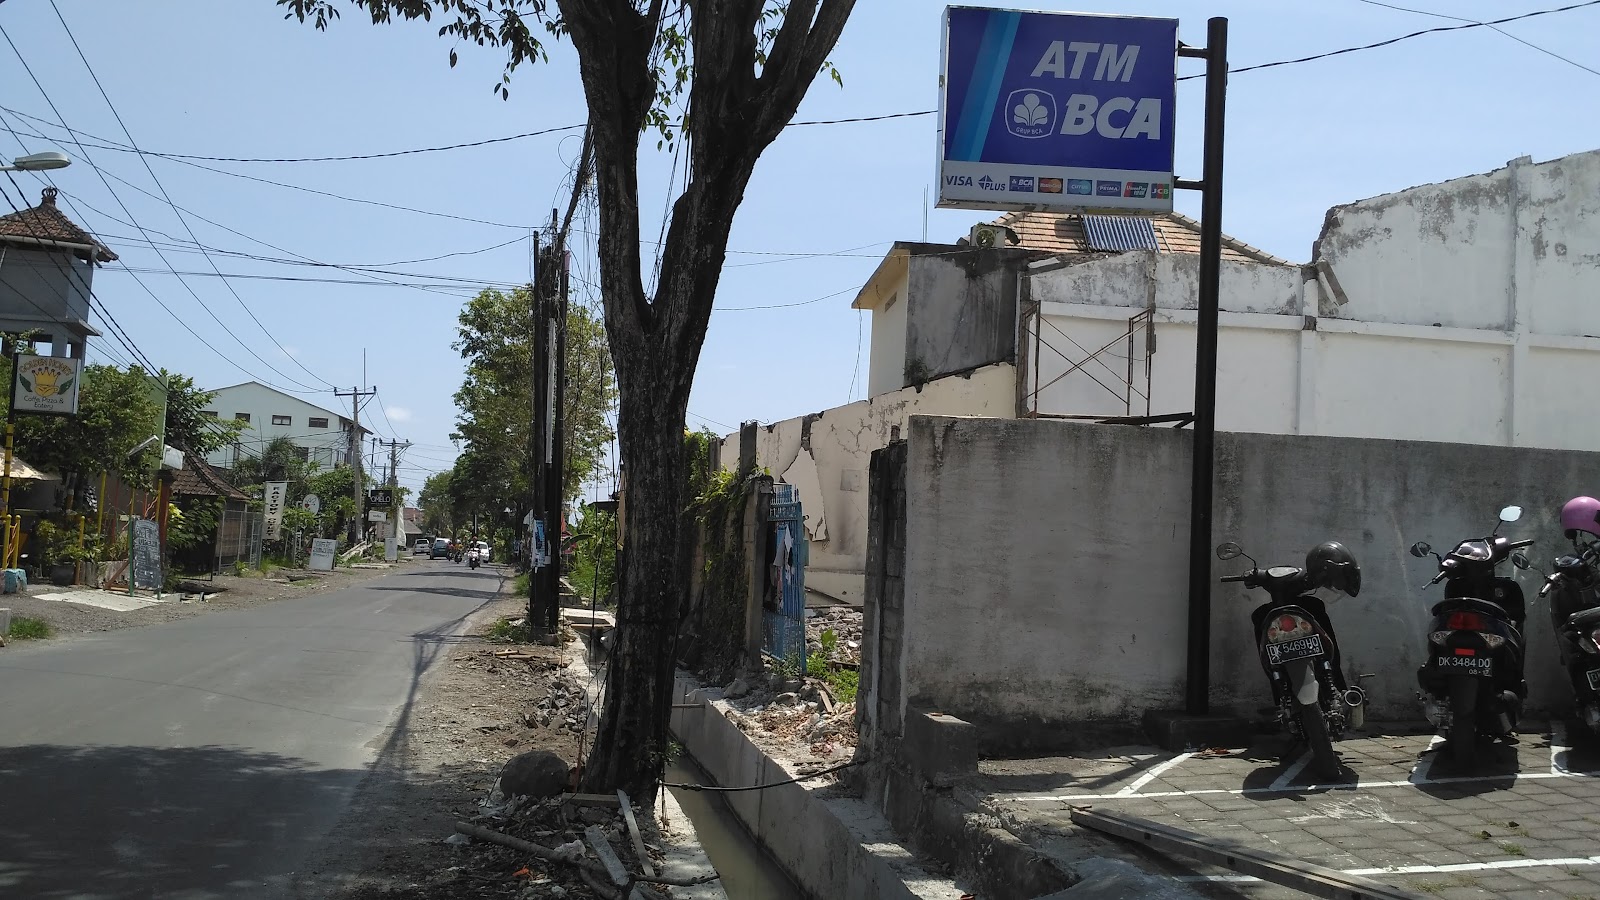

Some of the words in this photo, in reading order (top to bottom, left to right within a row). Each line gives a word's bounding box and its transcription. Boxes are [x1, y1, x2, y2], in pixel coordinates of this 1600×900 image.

[1030, 39, 1141, 83] ATM
[1060, 93, 1162, 141] BCA
[945, 175, 973, 187] VISA
[984, 182, 1006, 192] PLUS
[1018, 177, 1033, 186] BCA
[1269, 644, 1282, 656] DK
[1282, 639, 1307, 653] 5469
[1438, 656, 1450, 666] DK
[1452, 657, 1477, 667] 3484
